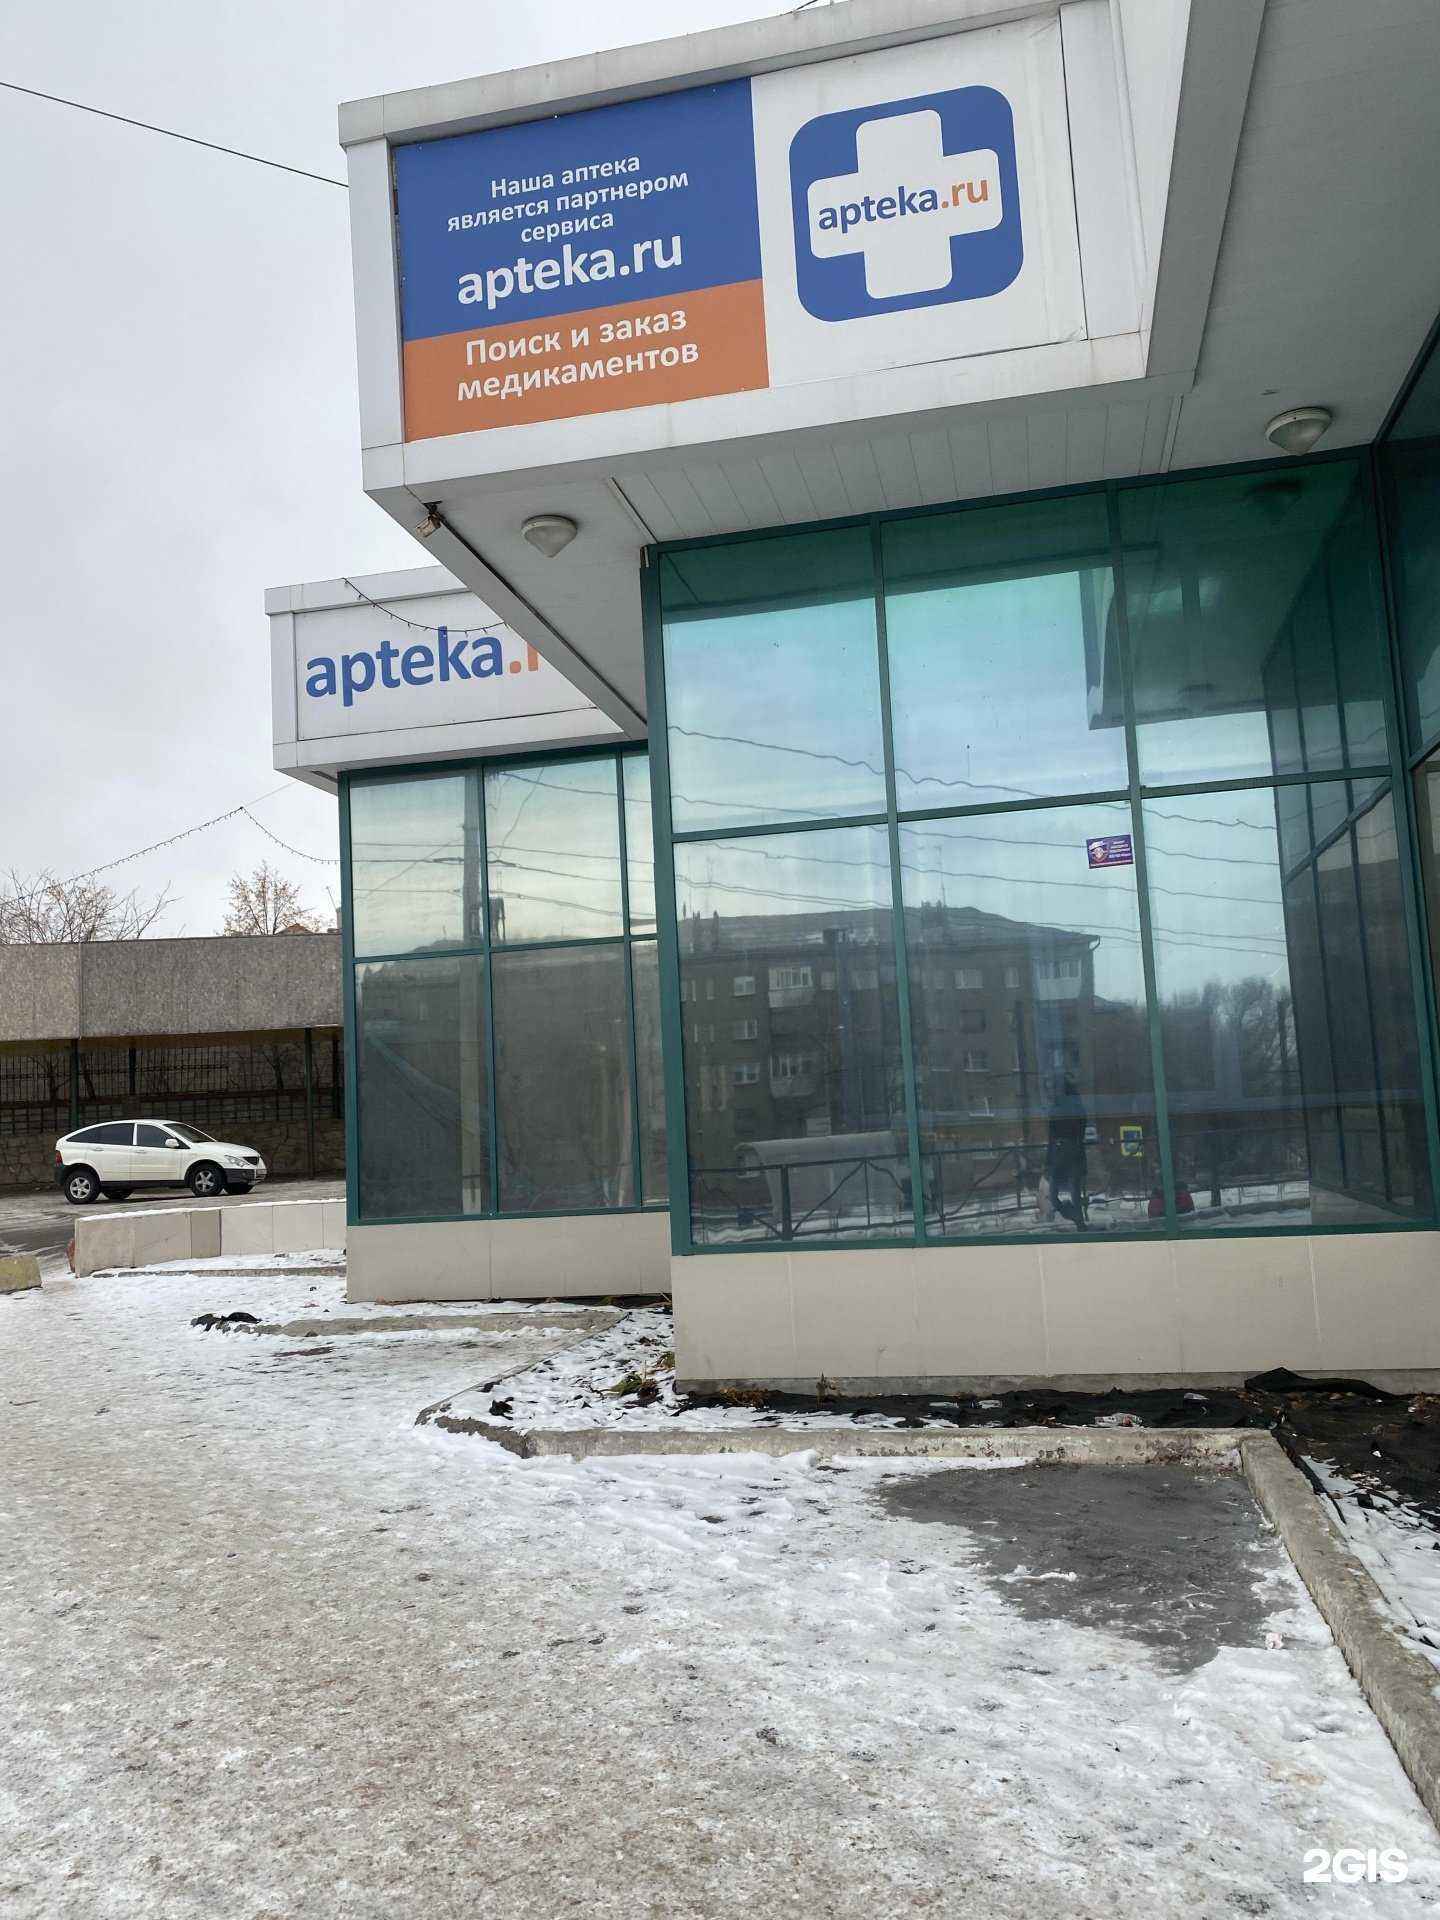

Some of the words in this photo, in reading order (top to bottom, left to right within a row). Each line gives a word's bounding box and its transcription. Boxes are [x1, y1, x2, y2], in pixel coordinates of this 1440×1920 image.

[447, 199, 549, 232] является
[556, 172, 689, 210] партнером
[491, 173, 554, 198] Наша
[561, 156, 640, 185] аптека
[520, 212, 614, 242] сервиса
[818, 179, 989, 234] apteka.ru
[457, 235, 682, 309] apteka.ru
[466, 331, 562, 365] Поиск
[571, 327, 590, 348] и
[600, 310, 687, 342] заказ
[457, 343, 699, 400] медикаментов
